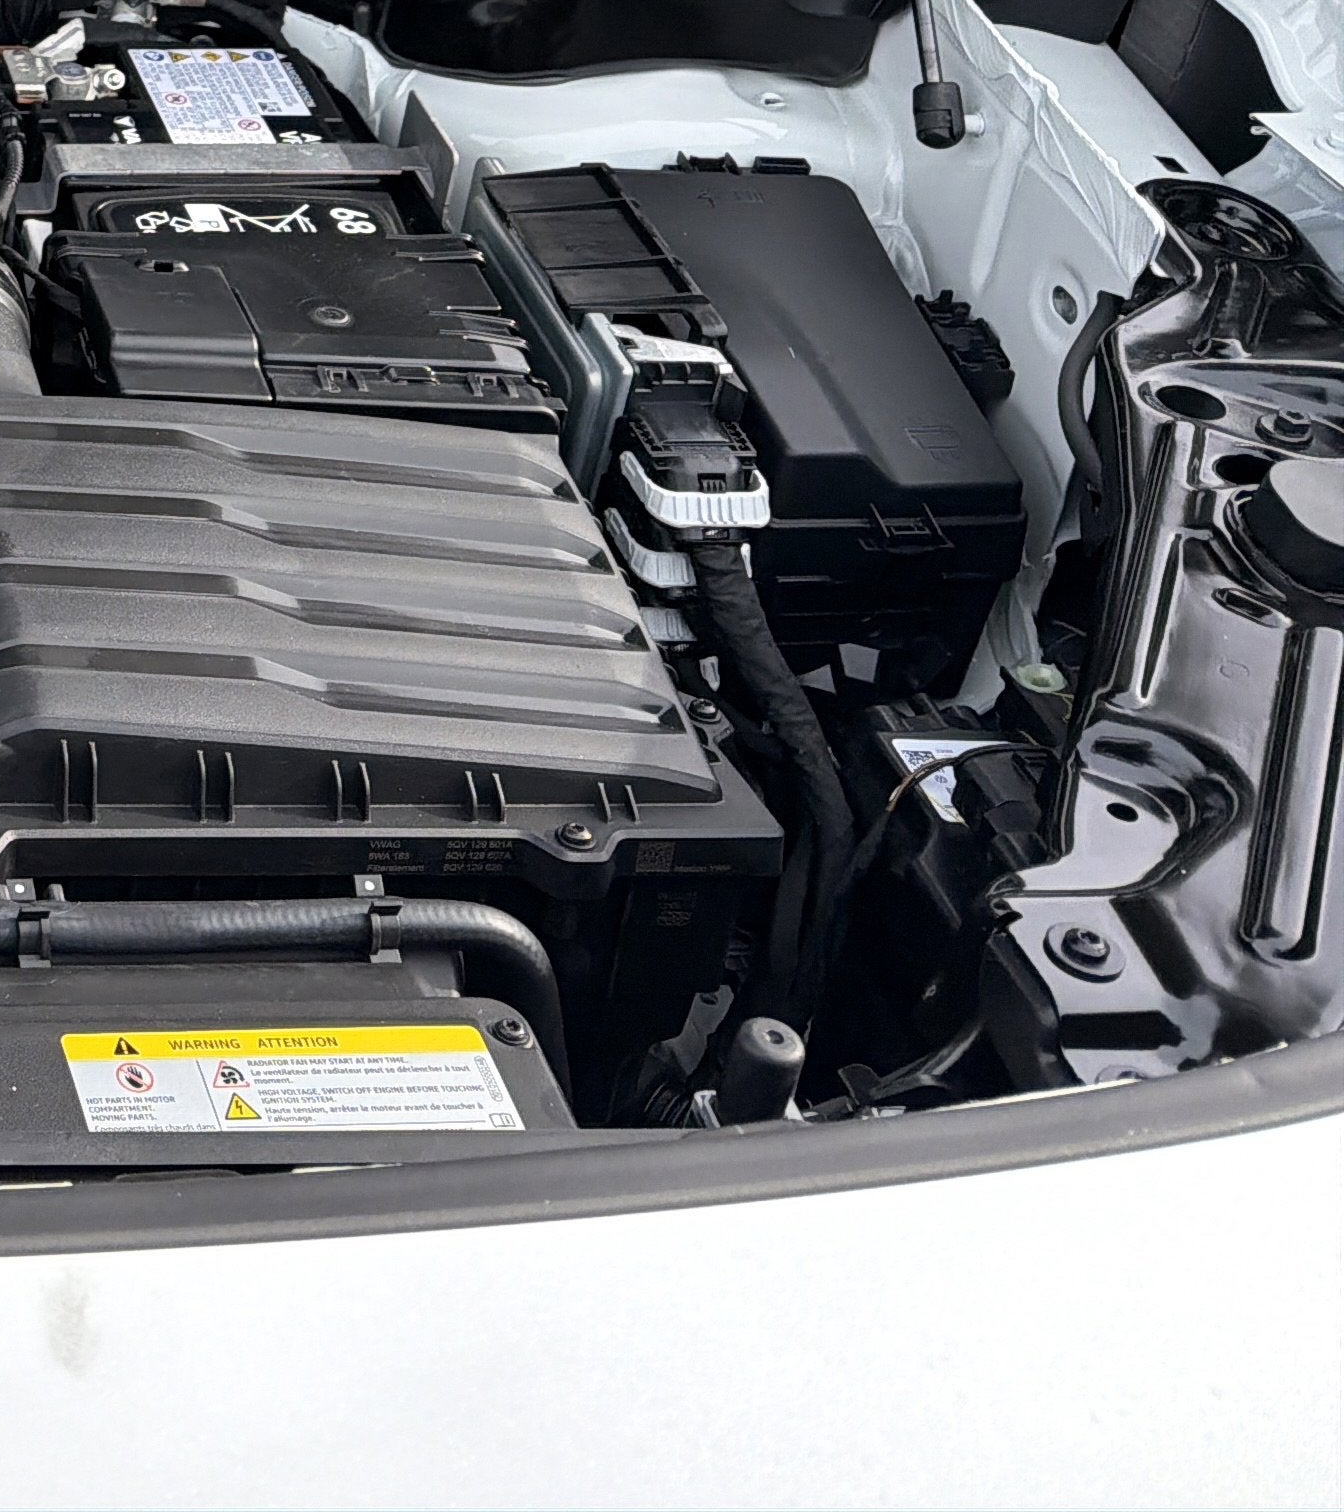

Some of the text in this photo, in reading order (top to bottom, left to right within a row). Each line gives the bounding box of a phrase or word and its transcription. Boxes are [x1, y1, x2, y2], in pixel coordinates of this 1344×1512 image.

[168, 1036, 339, 1051] WARNING ATTENTION
[263, 1068, 309, 1076] ventilateur
[323, 1067, 362, 1075] radiateur
[364, 1066, 384, 1074] peut
[321, 1087, 354, 1095] SWITCH
[373, 1086, 404, 1094] ENGINE
[406, 1085, 440, 1093] BEFORE
[440, 1085, 485, 1093] TOUCHING
[88, 1105, 155, 1113] COMPARTMENT.
[371, 1104, 402, 1112] moteur
